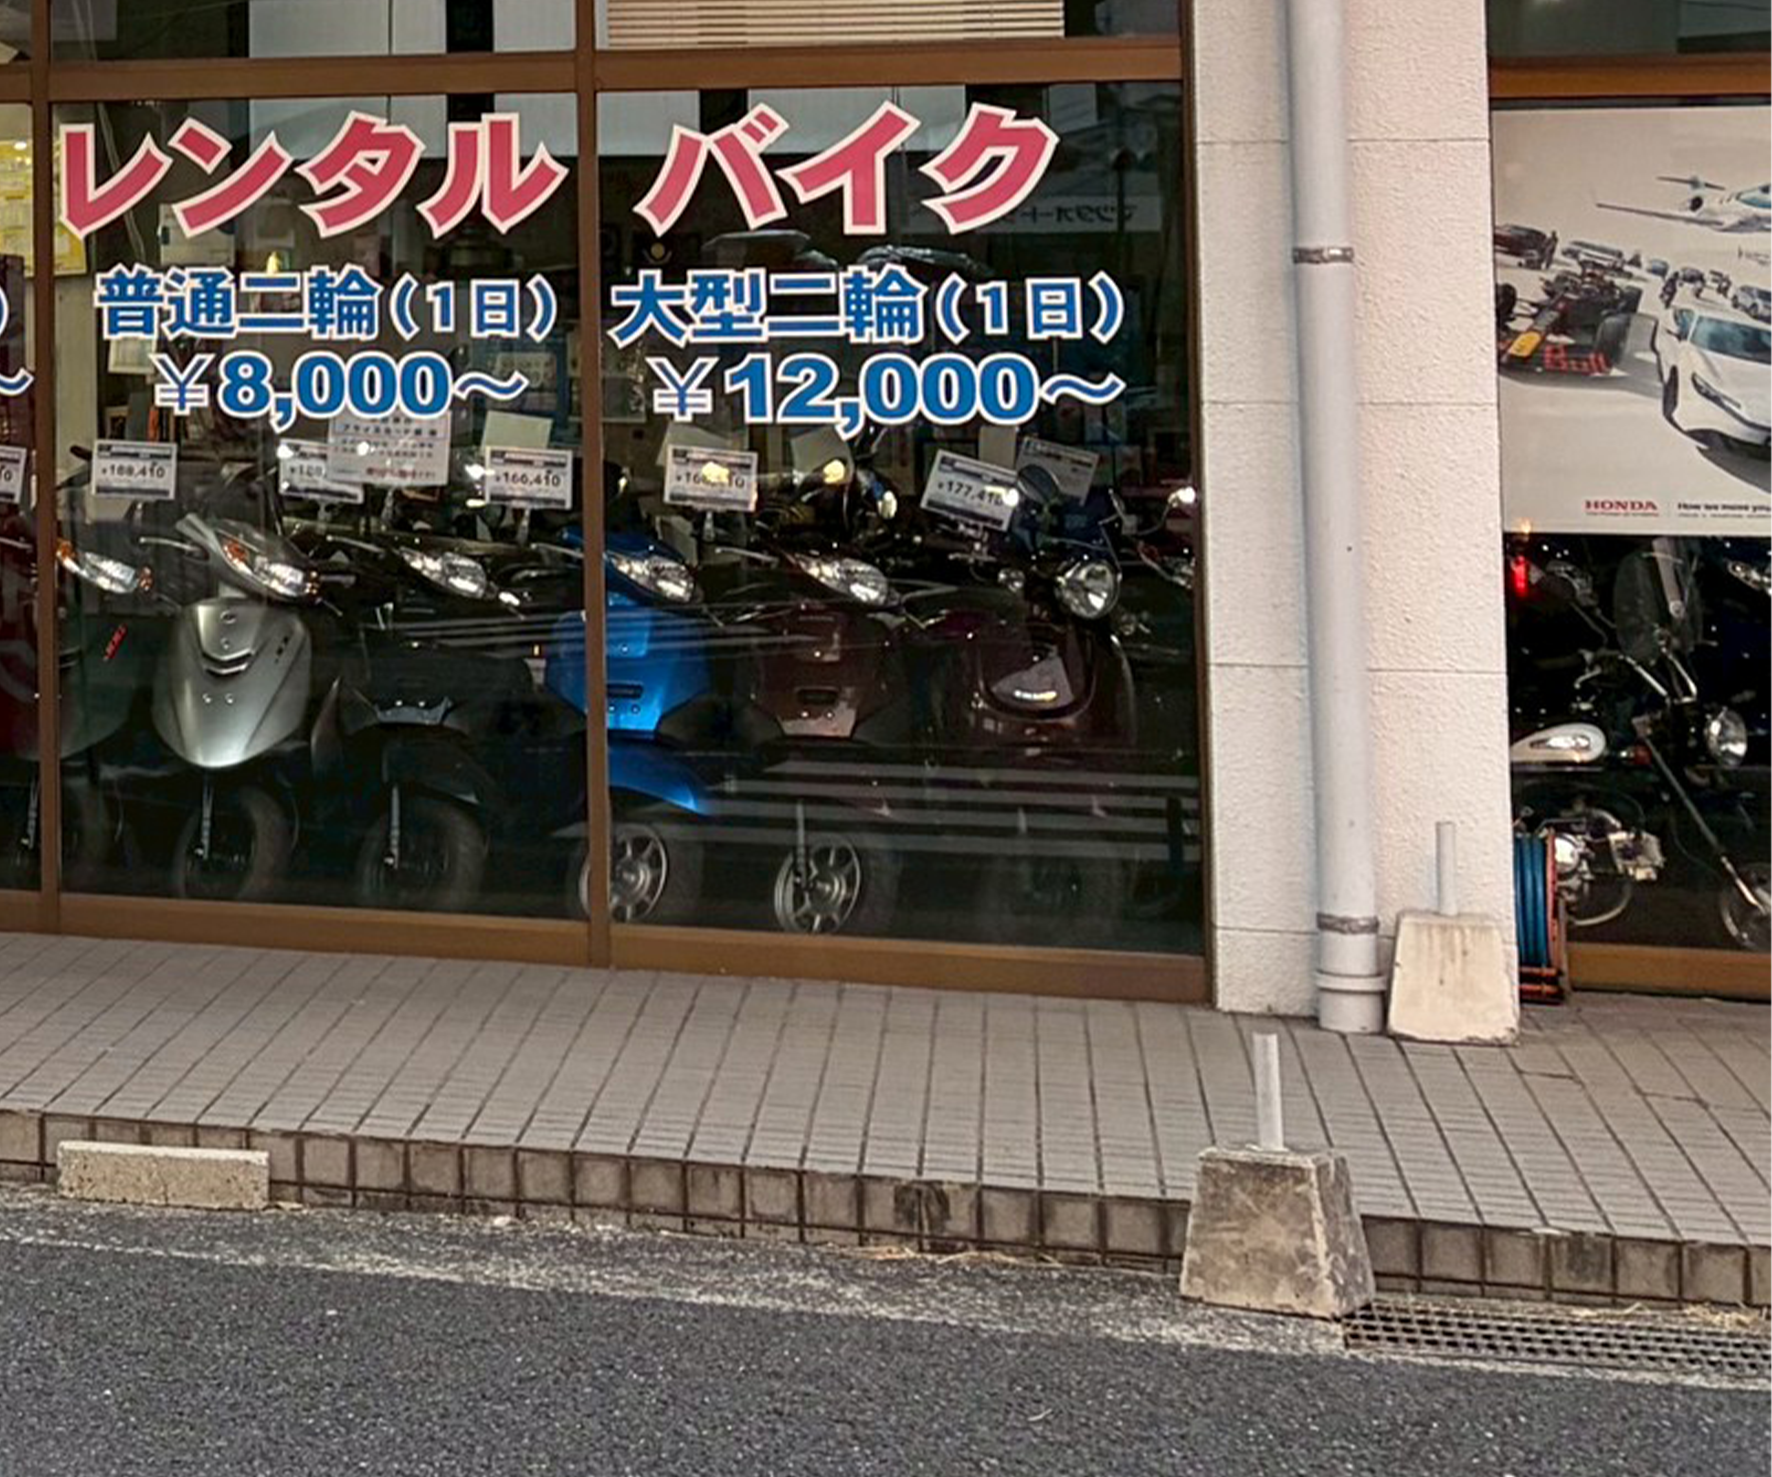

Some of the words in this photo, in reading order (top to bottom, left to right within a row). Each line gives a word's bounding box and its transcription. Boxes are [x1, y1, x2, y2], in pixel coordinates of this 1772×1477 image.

[59, 109, 570, 240] レンタル
[632, 100, 1060, 237] バイク
[1584, 499, 1658, 511] HONDA
